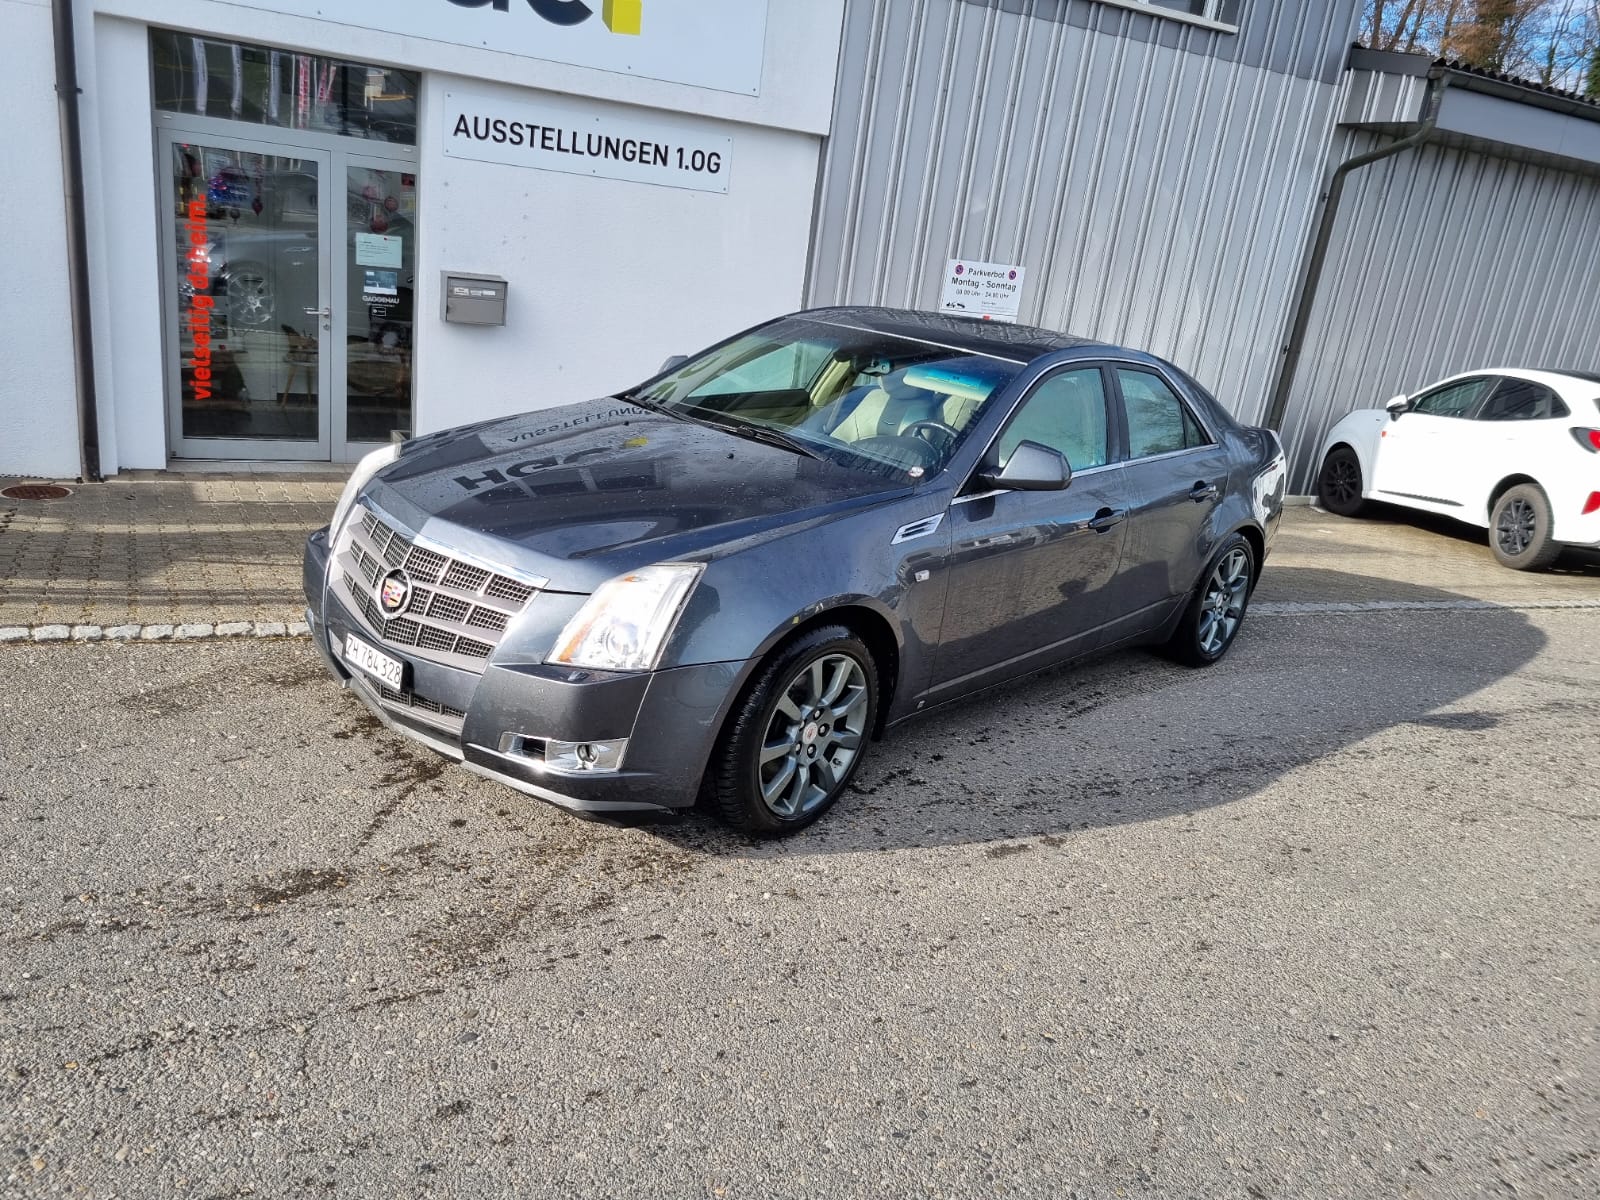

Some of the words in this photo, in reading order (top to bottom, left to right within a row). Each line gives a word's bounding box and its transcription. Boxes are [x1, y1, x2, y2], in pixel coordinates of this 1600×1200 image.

[453, 114, 668, 167] AUSSTELLUNGEN
[676, 147, 721, 174] 1.OG
[185, 194, 209, 289] daheim.
[951, 276, 980, 289] Montag
[986, 280, 1017, 293] Sonntag
[967, 267, 1005, 279] Parkverbot
[187, 295, 215, 400] vielseitig
[346, 636, 360, 659] ZH
[361, 645, 378, 672] 784
[381, 658, 401, 685] 328
